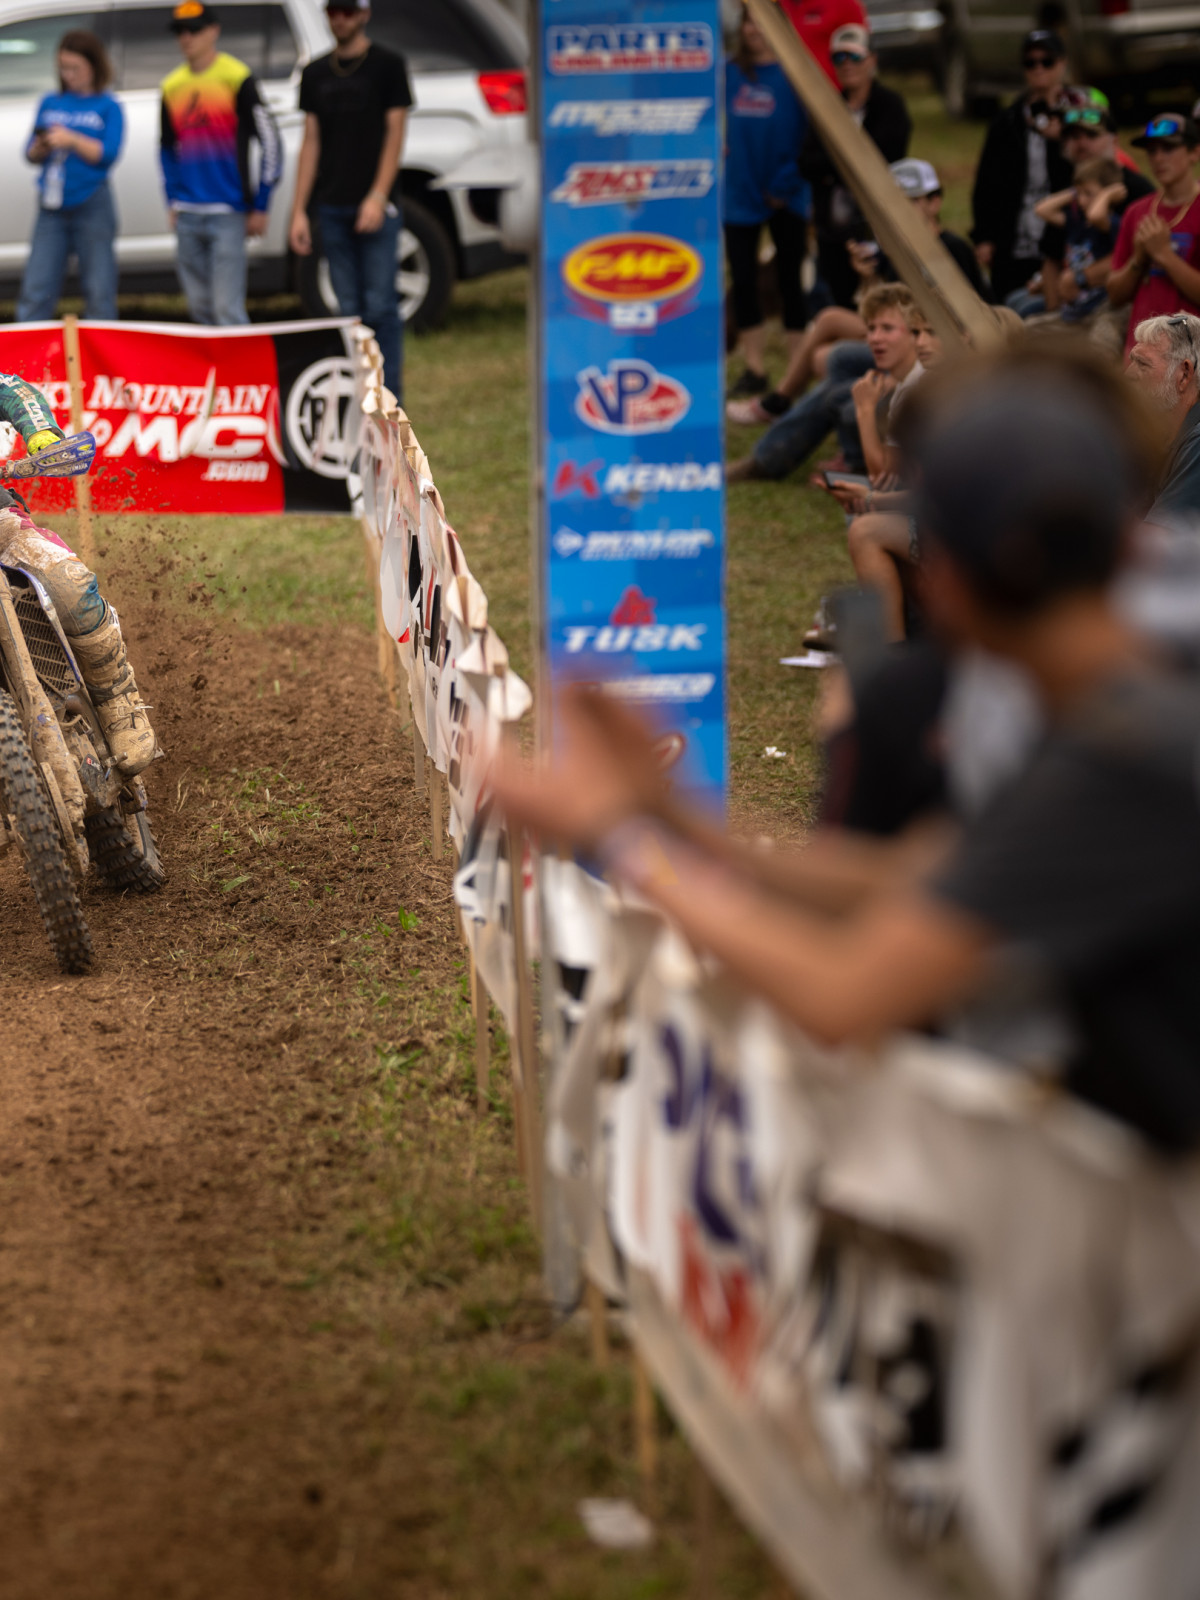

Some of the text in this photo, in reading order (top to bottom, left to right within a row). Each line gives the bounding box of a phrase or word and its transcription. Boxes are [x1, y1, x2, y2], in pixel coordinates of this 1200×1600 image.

[586, 368, 650, 424] VP
[604, 462, 723, 493] KENDA
[563, 624, 707, 653] TUSK
